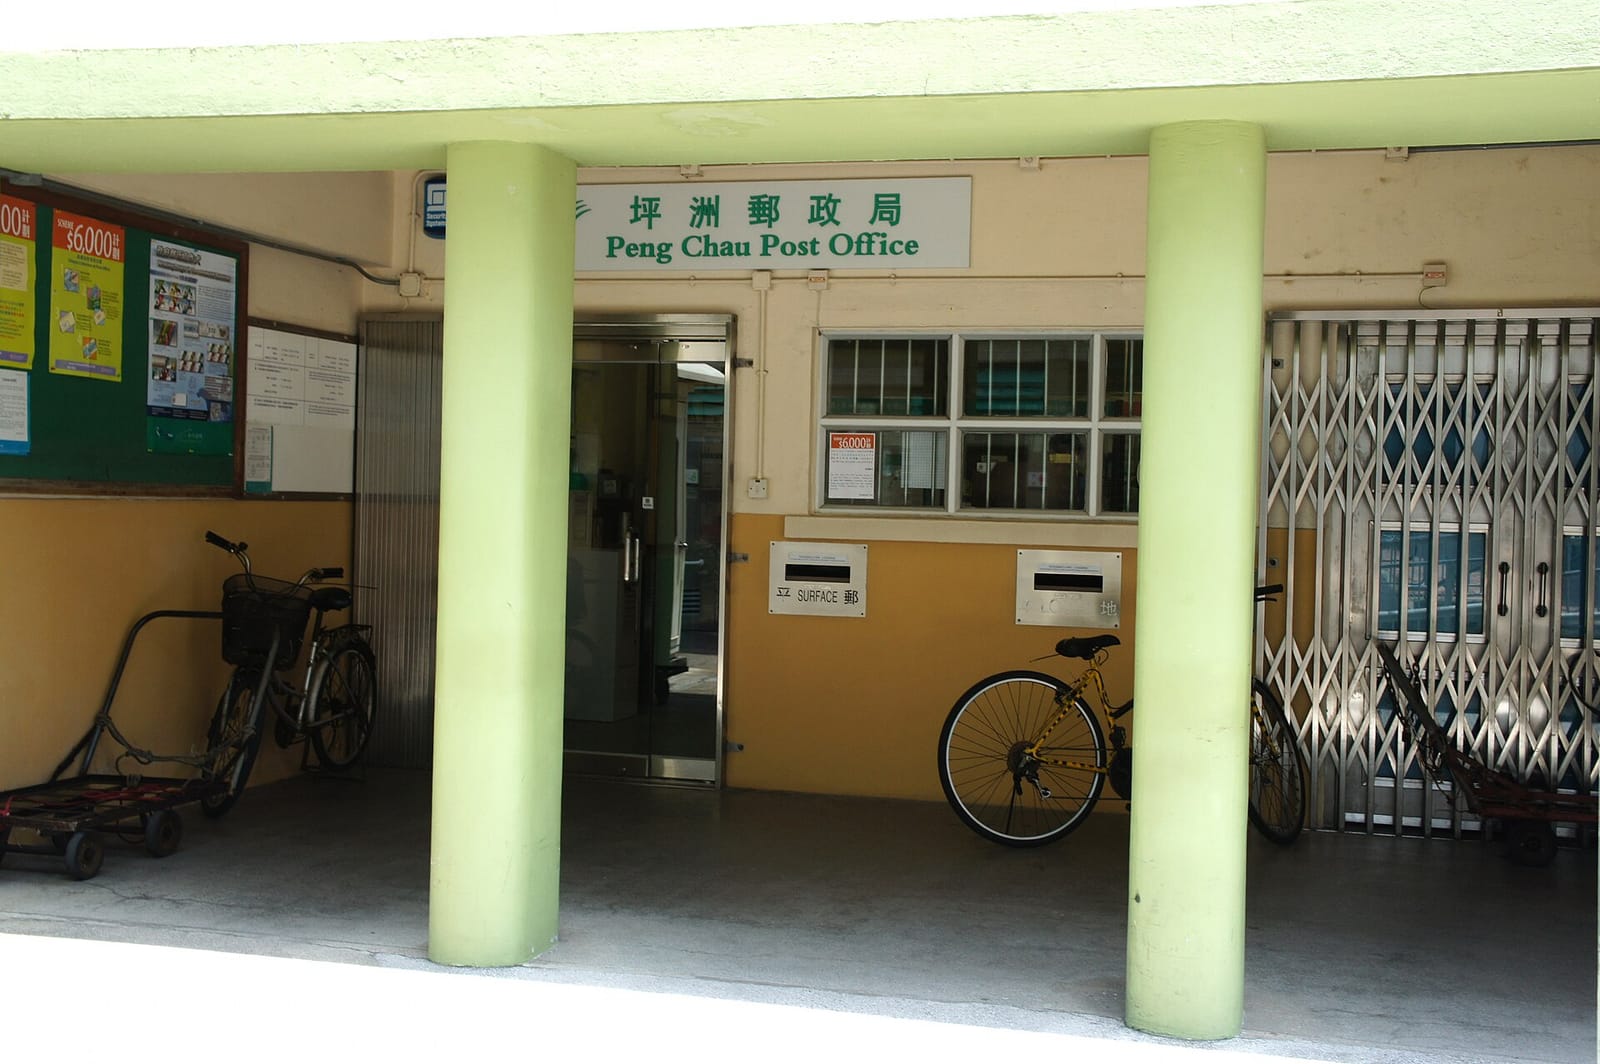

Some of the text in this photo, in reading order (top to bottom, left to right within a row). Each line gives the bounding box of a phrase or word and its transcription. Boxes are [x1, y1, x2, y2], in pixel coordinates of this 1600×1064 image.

[630, 193, 902, 229] 坪洲郵政局
[67, 224, 112, 258] $6,000
[606, 231, 919, 264] Peng Chau Post Office
[798, 589, 838, 603] SURFACE
[844, 589, 859, 605] 郵
[1100, 600, 1118, 616] 地
